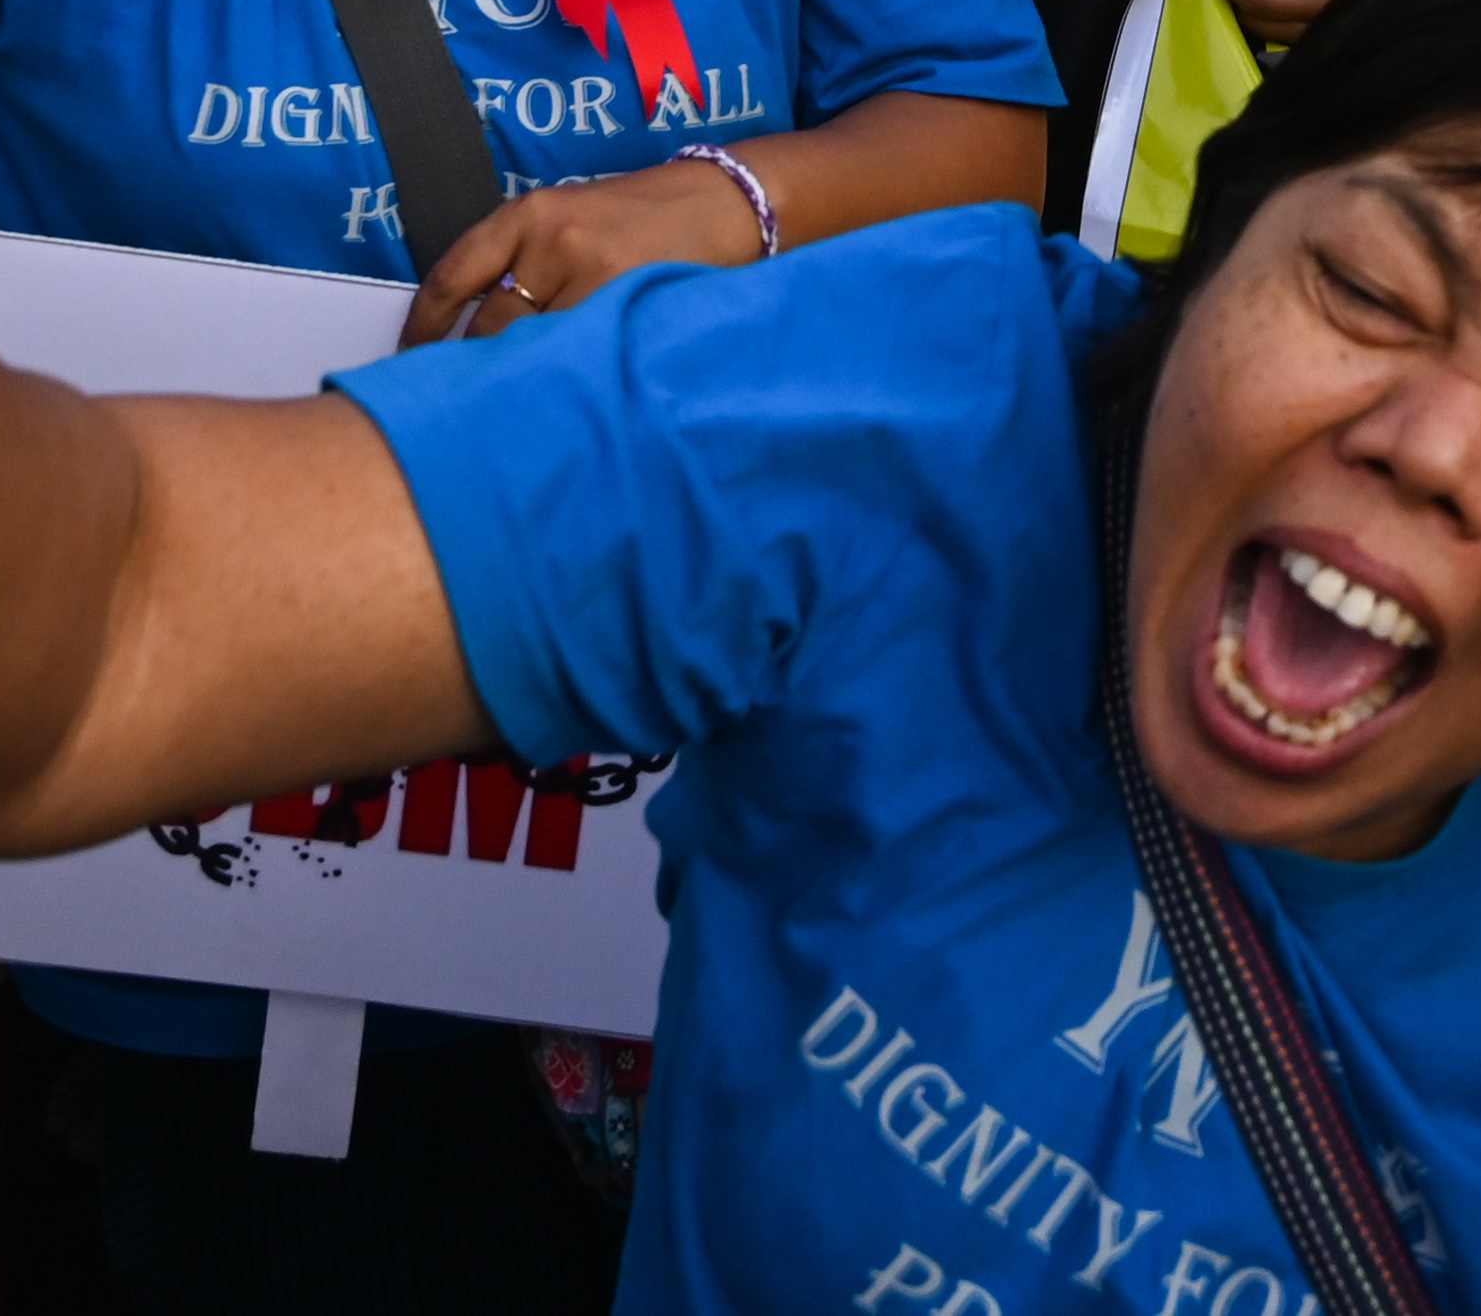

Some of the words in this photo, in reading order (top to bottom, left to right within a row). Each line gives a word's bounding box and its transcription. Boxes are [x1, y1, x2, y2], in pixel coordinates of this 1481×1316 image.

[187, 81, 376, 148] DIGN
[475, 76, 624, 138] FOR
[647, 64, 766, 133] ALL
[799, 983, 1164, 1293] DIGNITY
